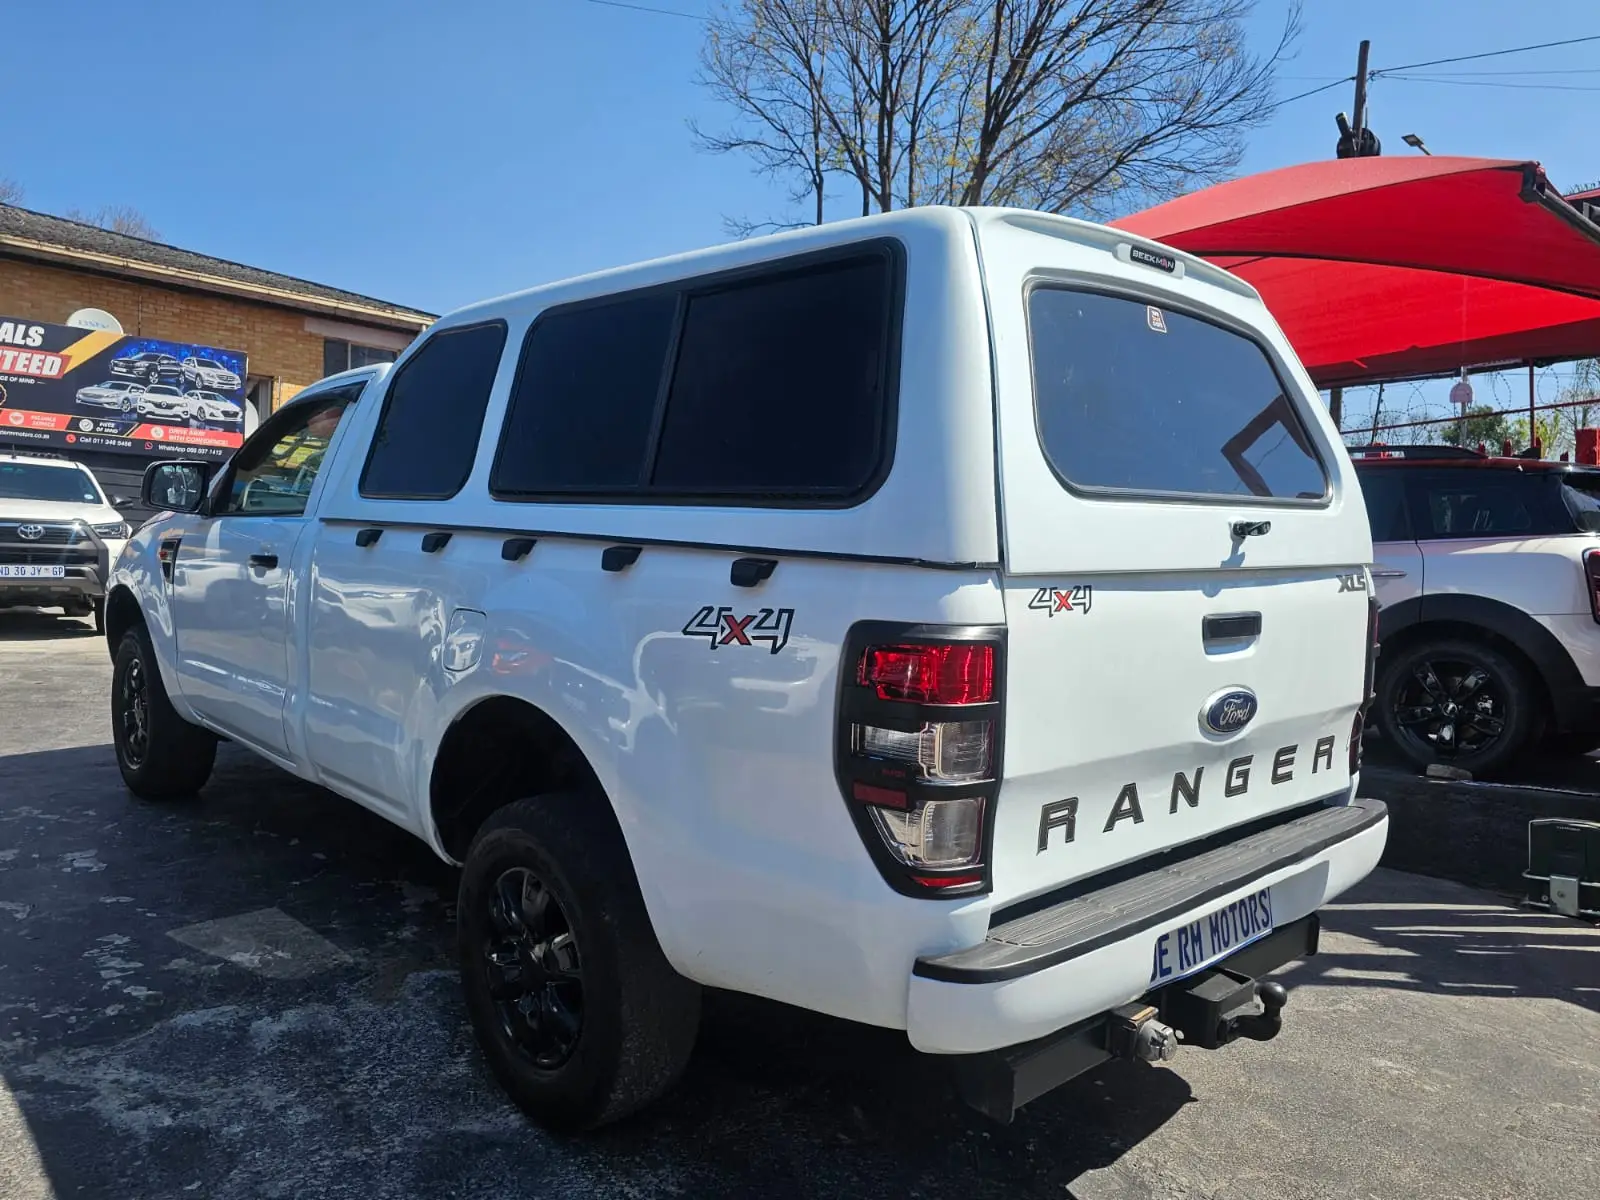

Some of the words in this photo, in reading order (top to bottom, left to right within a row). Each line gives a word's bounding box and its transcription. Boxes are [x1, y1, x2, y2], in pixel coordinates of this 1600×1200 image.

[1132, 249, 1175, 269] BEEKMAN
[0, 321, 45, 347] ALS
[0, 350, 63, 376] TEED
[18, 377, 36, 385] MIND
[158, 444, 186, 453] WhatsApp
[30, 566, 42, 576] JY
[52, 566, 64, 576] GP
[1335, 574, 1366, 593] XLS
[1219, 698, 1251, 725] Ford
[1037, 735, 1336, 855] RANGER
[1177, 920, 1204, 971] RM
[1208, 889, 1270, 955] MOTORS
